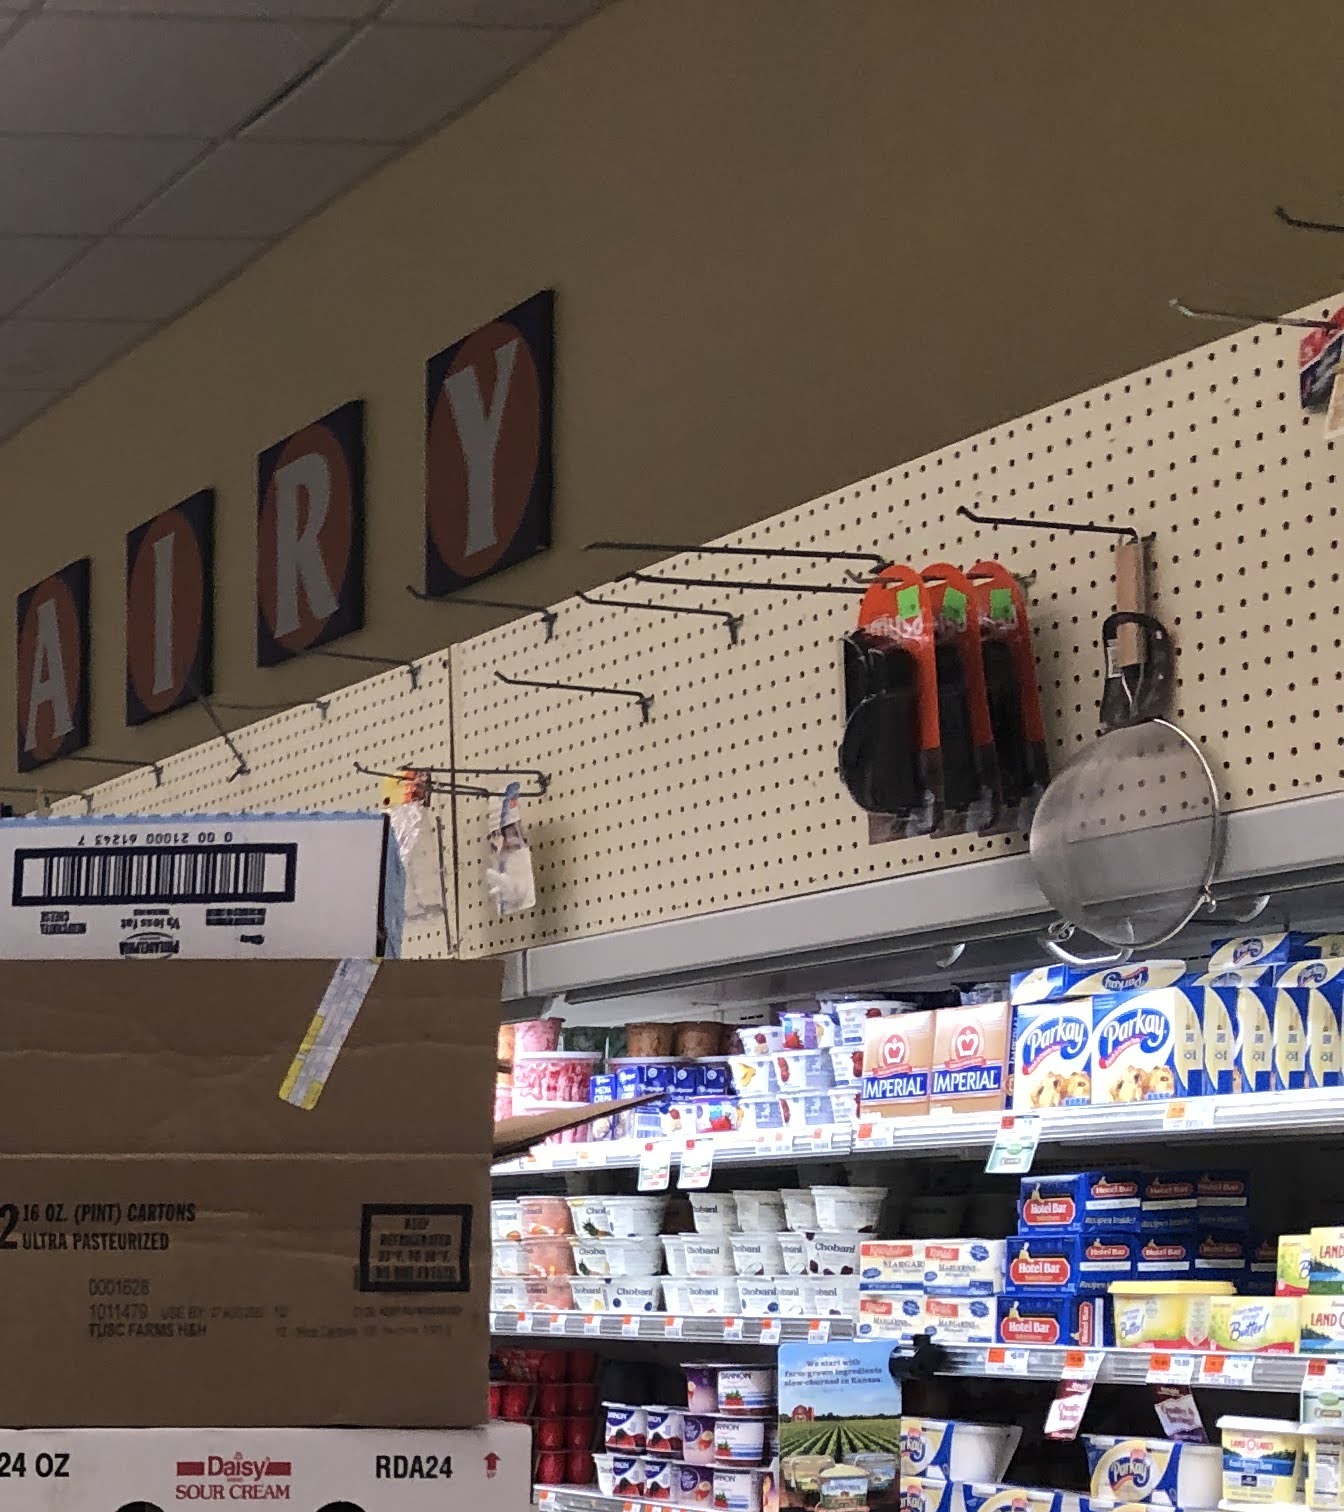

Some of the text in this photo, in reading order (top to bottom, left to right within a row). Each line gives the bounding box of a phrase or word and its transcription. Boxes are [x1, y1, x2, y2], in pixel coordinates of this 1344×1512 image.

[1027, 1020, 1084, 1052] Parkay
[1104, 1008, 1165, 1046] Parkay
[863, 1077, 925, 1099] IMPERIAL
[933, 1069, 998, 1093] IMPERIAL
[22, 1203, 40, 1222] 16
[44, 1203, 67, 1222] OZ.
[73, 1202, 123, 1224] (PINT)
[126, 1202, 197, 1223] CARTONS
[1030, 1200, 1068, 1214] Hotel Bar
[21, 1231, 170, 1252] ULTRA PASTEURIZED
[814, 1241, 857, 1254] Chobani
[1018, 1262, 1062, 1275] Hotel Bar
[615, 1286, 654, 1297] Chobani
[1008, 1321, 1050, 1334] Hotel Bar
[1310, 1312, 1337, 1326] LAND
[34, 1452, 71, 1479] OZ
[207, 1454, 268, 1482] Daisy
[374, 1454, 454, 1480] RDA24
[1111, 1458, 1149, 1487] Parkay
[174, 1483, 291, 1501] SOUR CREAM
